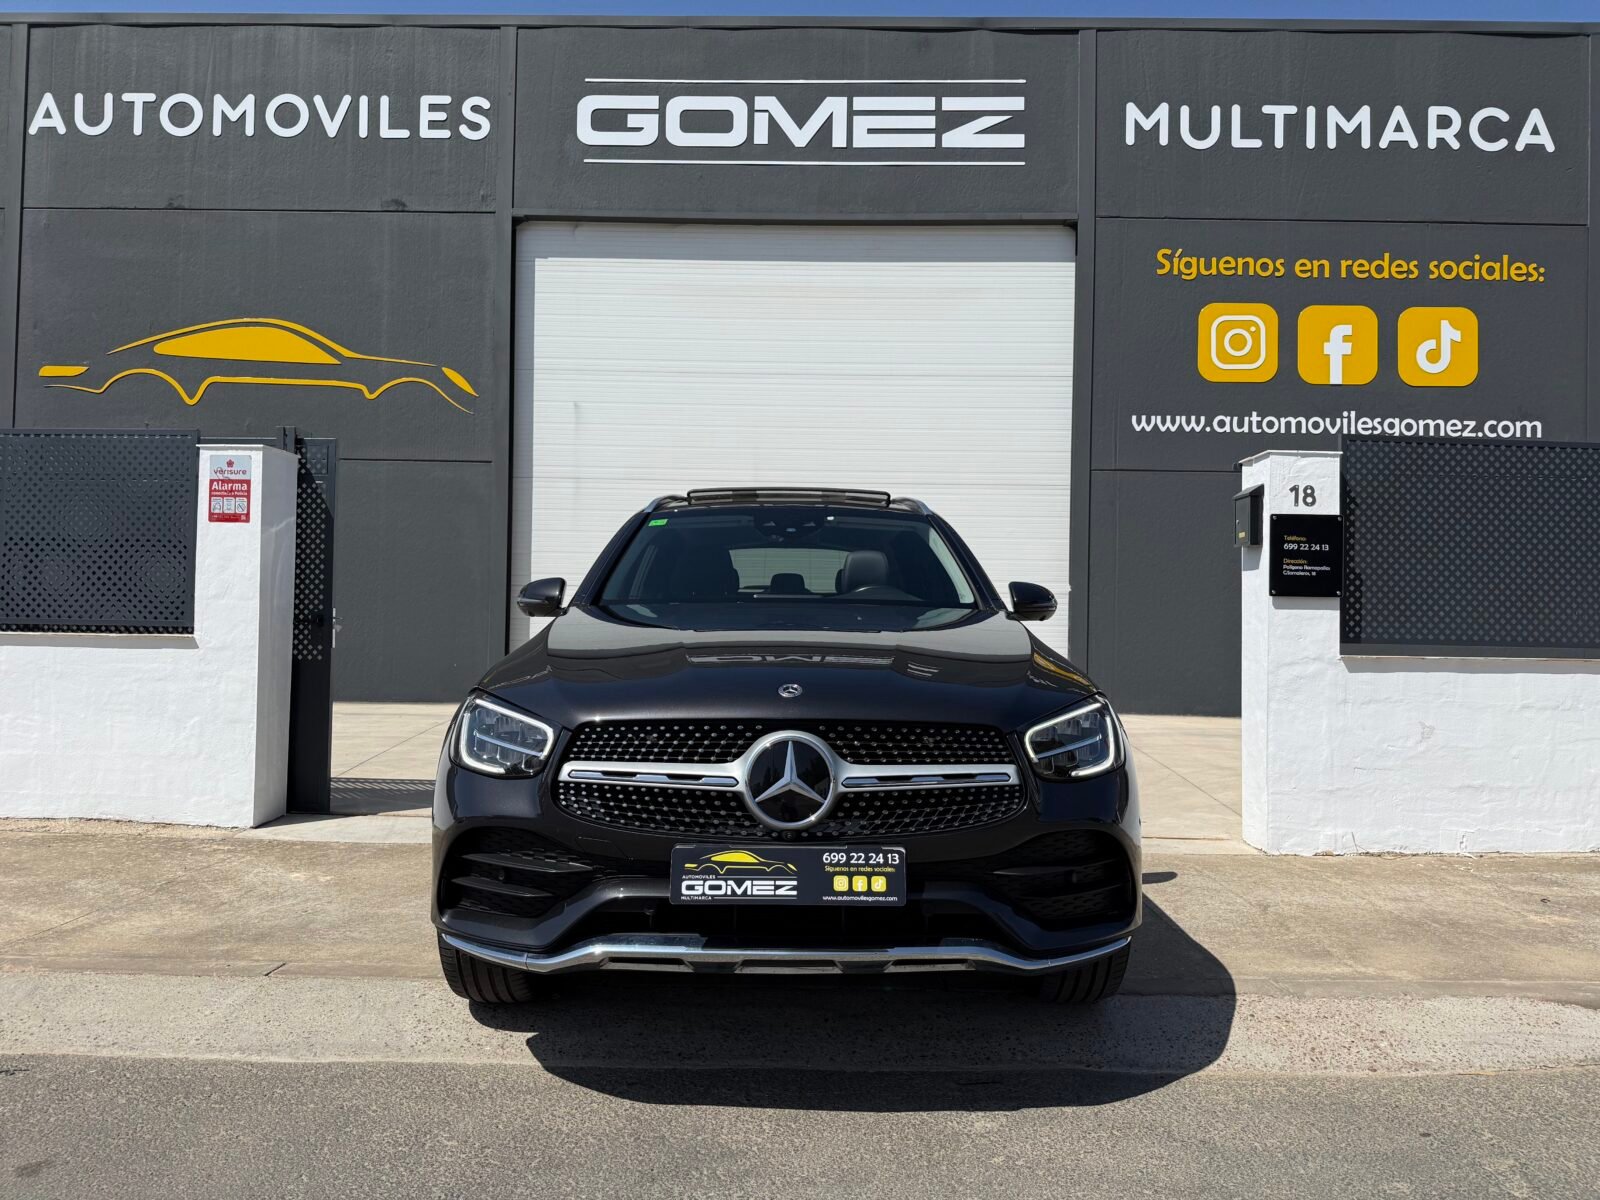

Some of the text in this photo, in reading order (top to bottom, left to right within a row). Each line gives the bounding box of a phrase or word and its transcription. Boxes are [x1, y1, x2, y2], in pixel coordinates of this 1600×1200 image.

[28, 92, 491, 141] AUTOMOVILES
[576, 94, 1026, 148] GOMEZ
[1125, 101, 1556, 153] MULTIMARCA
[1156, 248, 1546, 283] Síguenos en redes sociales:
[1131, 410, 1543, 439] www.automovilesgomez.com
[211, 481, 248, 491] Alarma
[1289, 484, 1317, 507] 18
[1299, 543, 1309, 551] 22
[1310, 543, 1320, 551] 24
[822, 852, 900, 865] 699 22 24 13
[681, 880, 798, 896] GOMEZ
